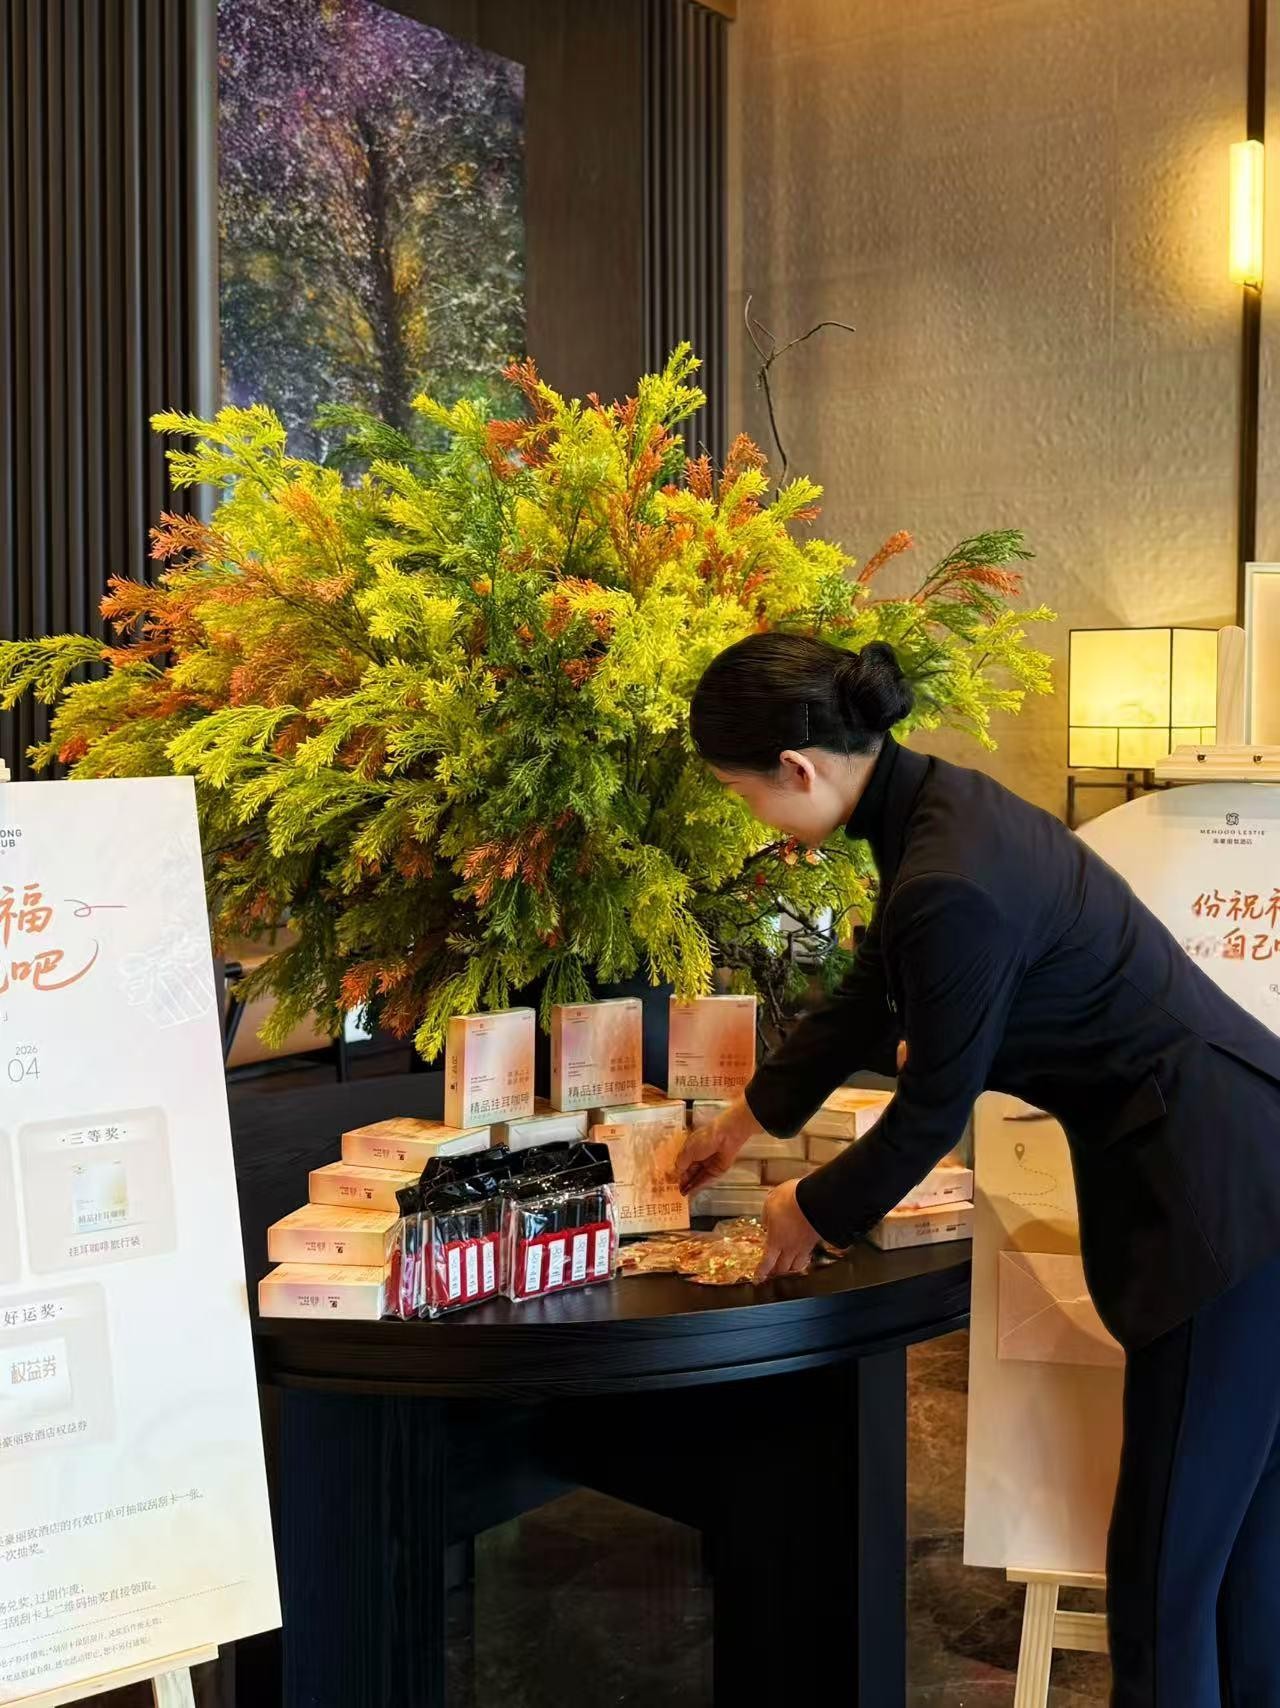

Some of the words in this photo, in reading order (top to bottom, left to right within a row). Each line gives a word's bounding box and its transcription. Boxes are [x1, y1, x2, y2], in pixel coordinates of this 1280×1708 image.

[1222, 927, 1280, 960] 自己
[0, 937, 99, 991] 吧
[15, 1046, 38, 1055] 2026
[7, 1057, 40, 1082] 04
[568, 1080, 638, 1098] 精品挂耳咖啡
